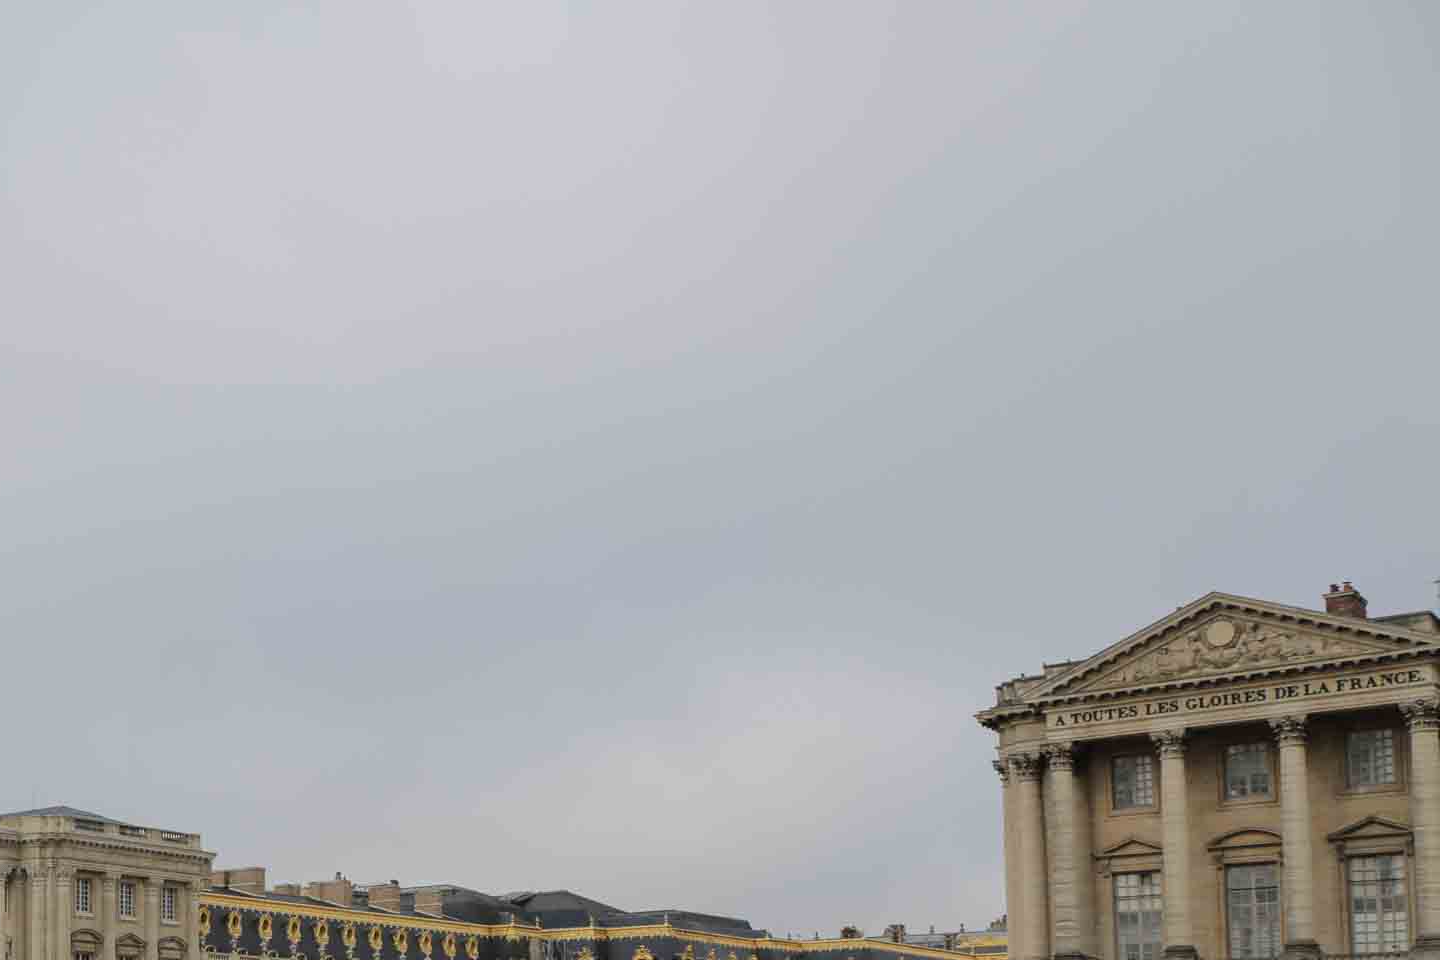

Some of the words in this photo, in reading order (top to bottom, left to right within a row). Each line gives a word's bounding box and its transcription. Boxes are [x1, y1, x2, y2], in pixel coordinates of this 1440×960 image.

[1054, 715, 1066, 728] A
[1070, 705, 1138, 724] TOUTES
[1145, 699, 1180, 717] LES
[1184, 688, 1266, 711] GLOIRES
[1274, 684, 1299, 700] DE
[1303, 682, 1330, 695] LA
